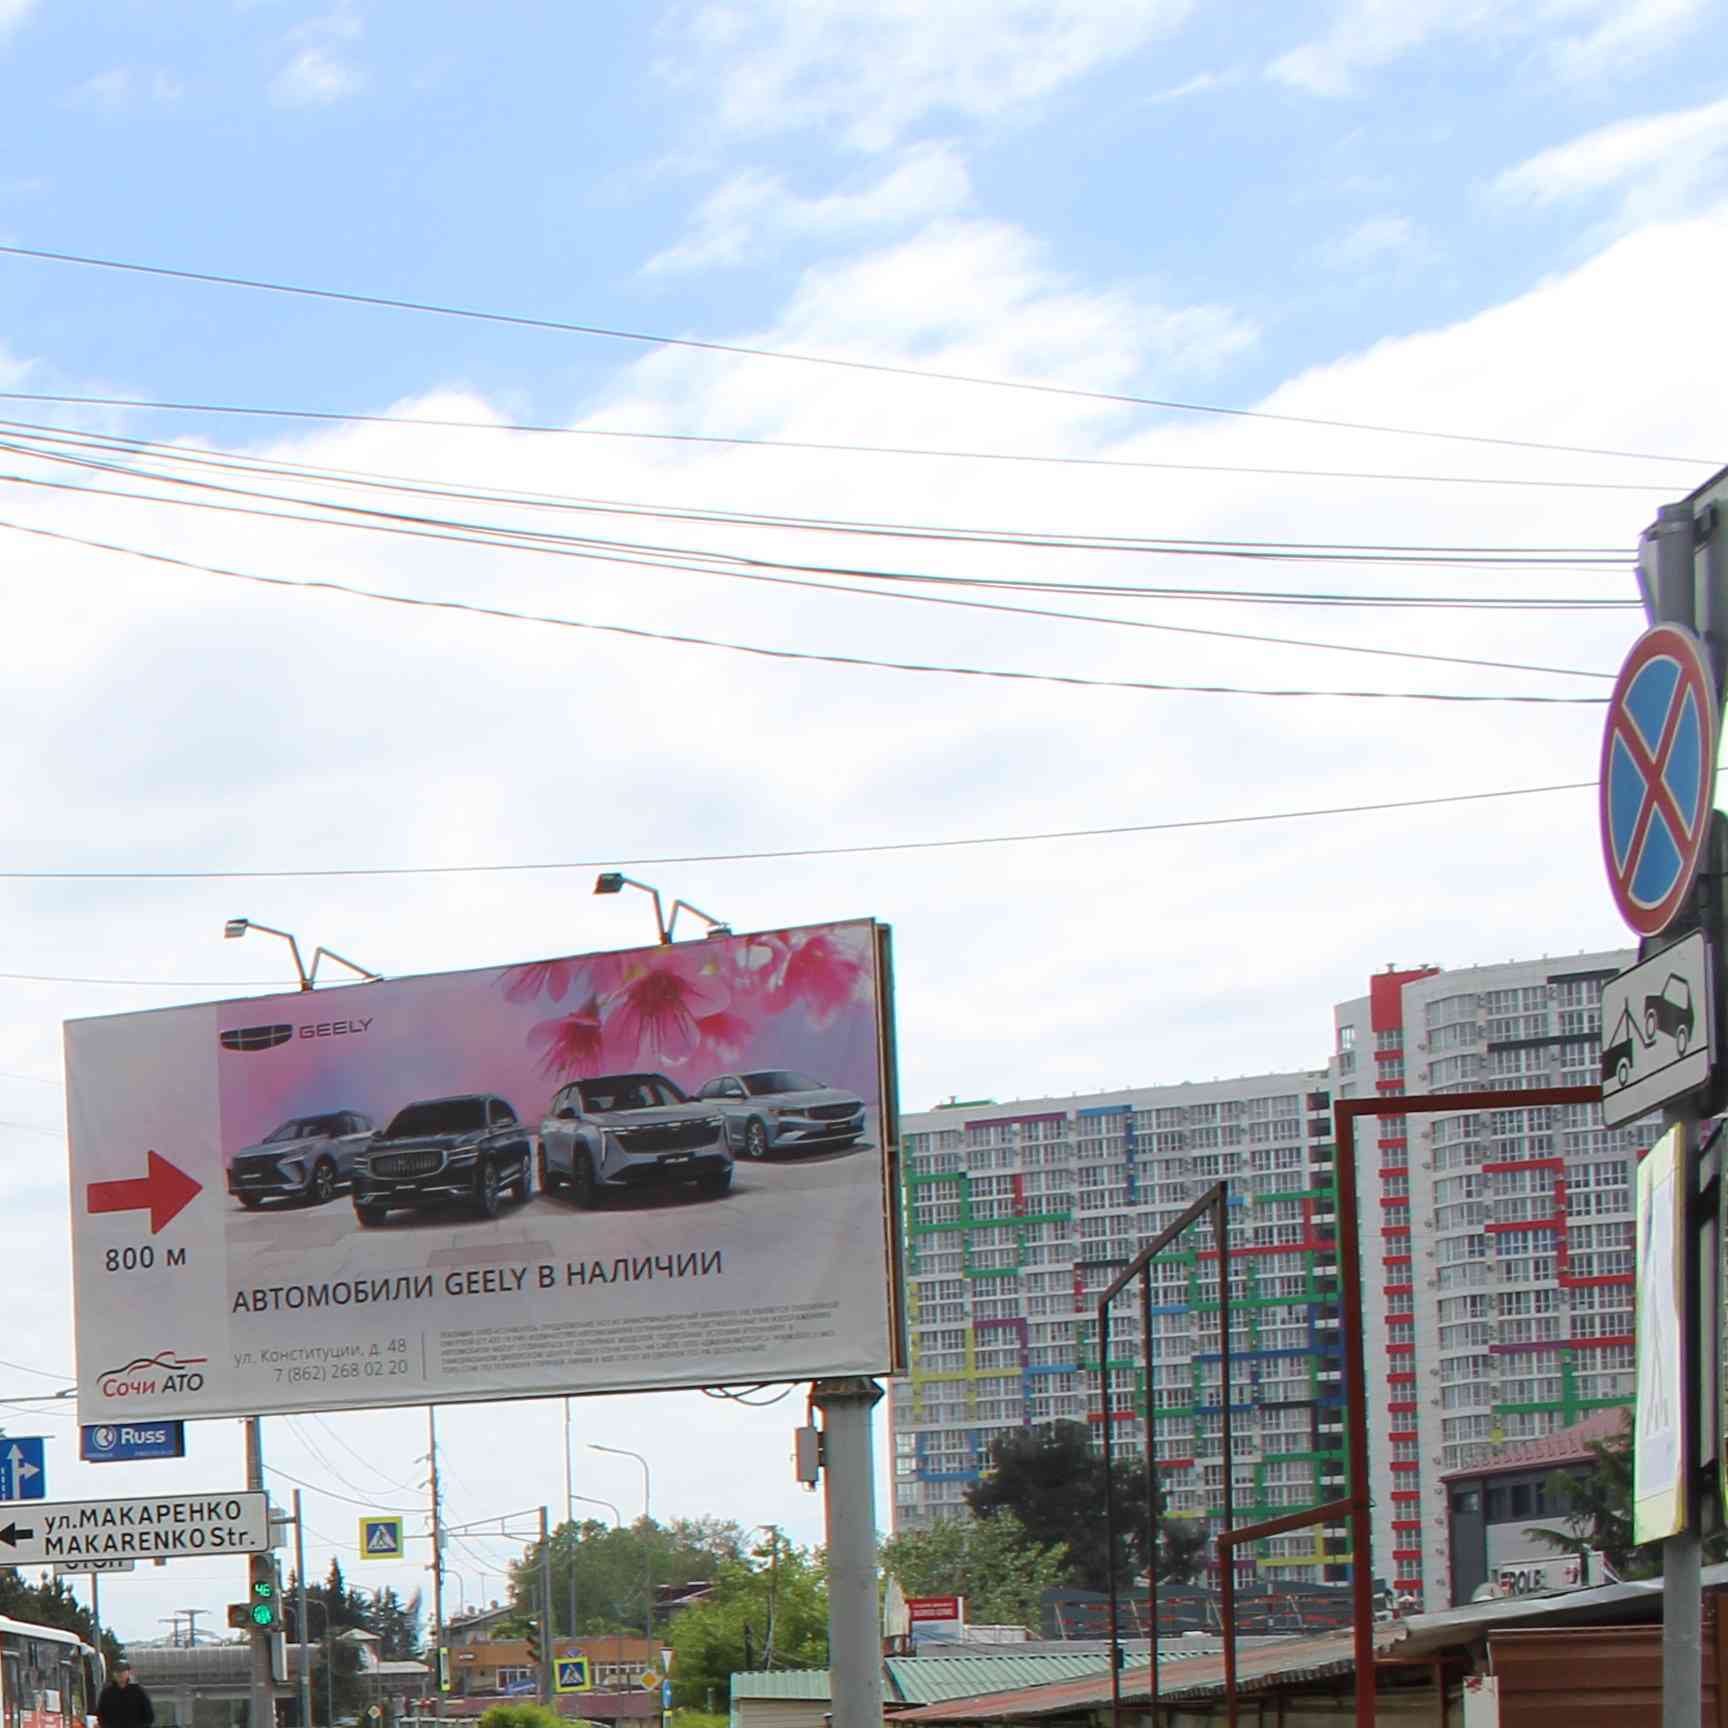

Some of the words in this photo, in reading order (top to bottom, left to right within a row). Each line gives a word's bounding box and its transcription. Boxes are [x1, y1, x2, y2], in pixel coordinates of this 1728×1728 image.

[299, 1017, 374, 1039] GEELY
[105, 1246, 154, 1271] 800
[166, 1248, 186, 1266] м
[232, 1275, 433, 1314] АВТОМОБИЛИ
[445, 1267, 527, 1296] GEELY
[538, 1265, 555, 1289] В
[567, 1250, 722, 1287] НАЛИЧИИ
[388, 1338, 406, 1354] 48
[274, 1368, 283, 1384] 7
[287, 1362, 327, 1383] (862)
[331, 1361, 360, 1379] 268
[365, 1359, 385, 1377] 02
[389, 1358, 409, 1376] 20
[102, 1378, 156, 1398] Сочи
[162, 1372, 204, 1394] АТО
[120, 1427, 166, 1445] Russ
[45, 1528, 205, 1555] MAKARENKO
[211, 1526, 256, 1548] Str.
